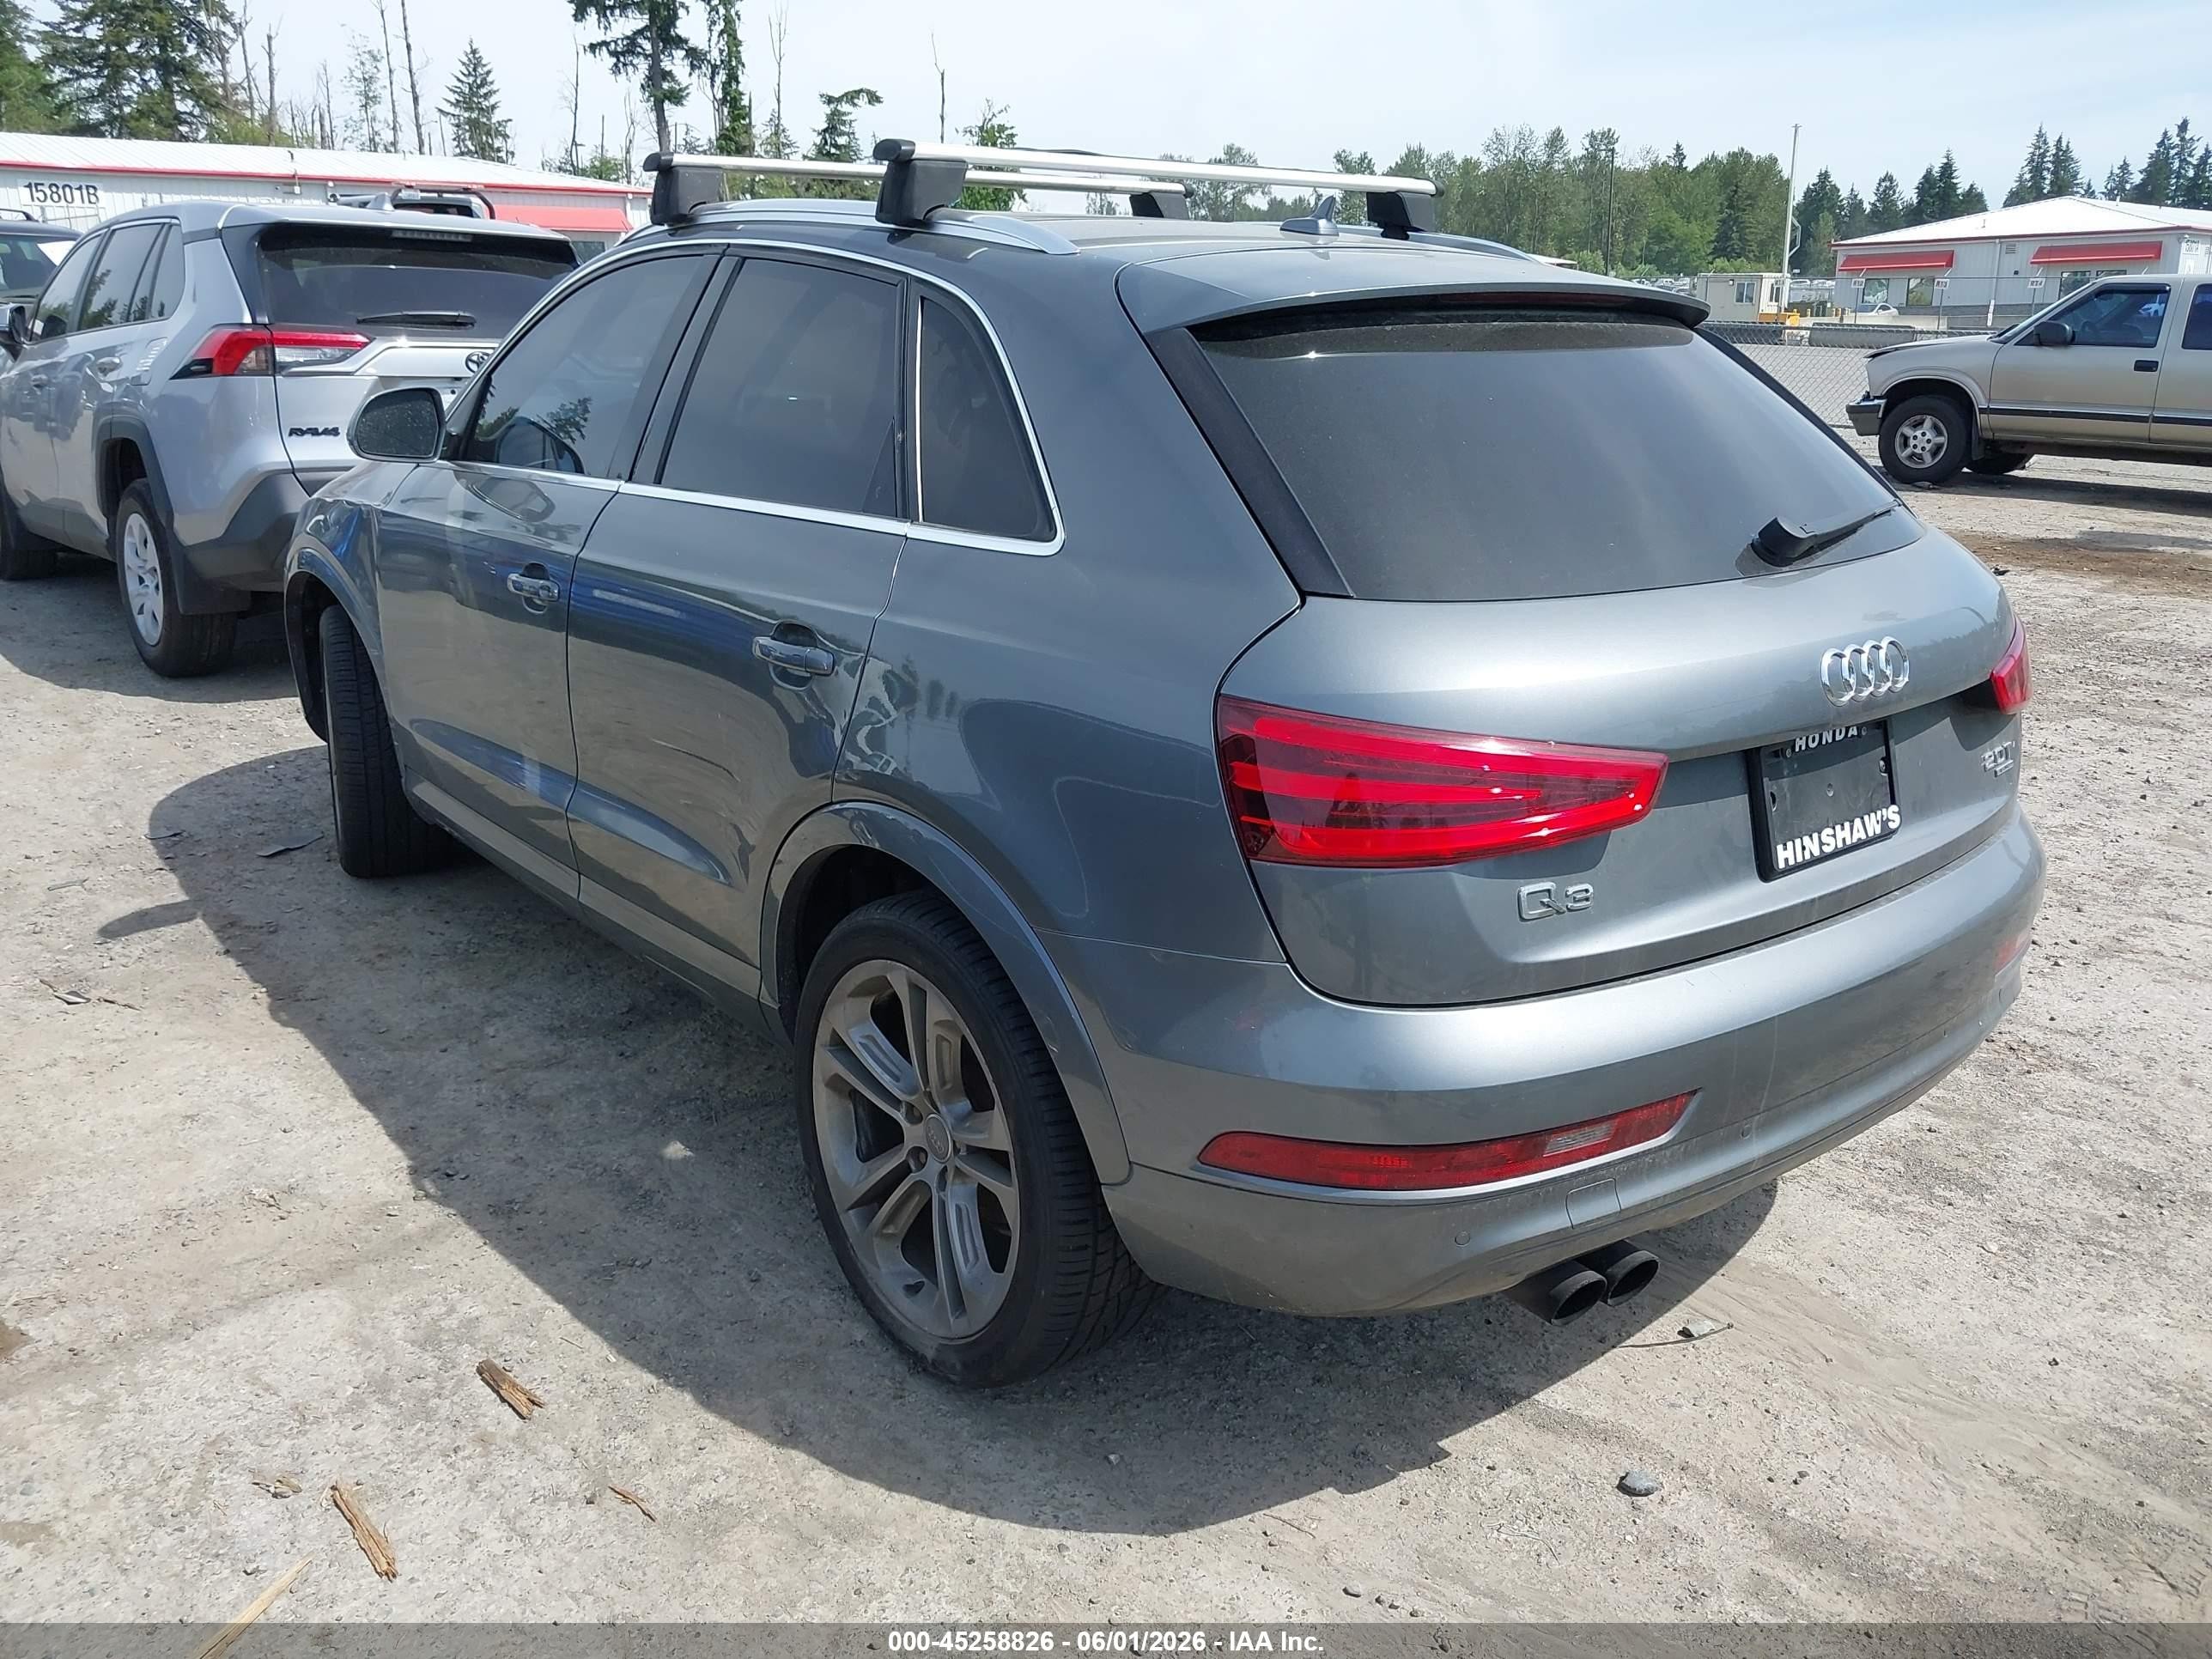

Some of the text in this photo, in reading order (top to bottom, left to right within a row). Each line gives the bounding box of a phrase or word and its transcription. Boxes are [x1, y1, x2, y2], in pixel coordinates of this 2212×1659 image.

[24, 182, 99, 204] 15801B
[289, 427, 340, 436] RAV4
[1795, 726, 1858, 752] HONDA
[1776, 805, 1901, 869] HINSHAW'S
[1517, 882, 1594, 922] Q3
